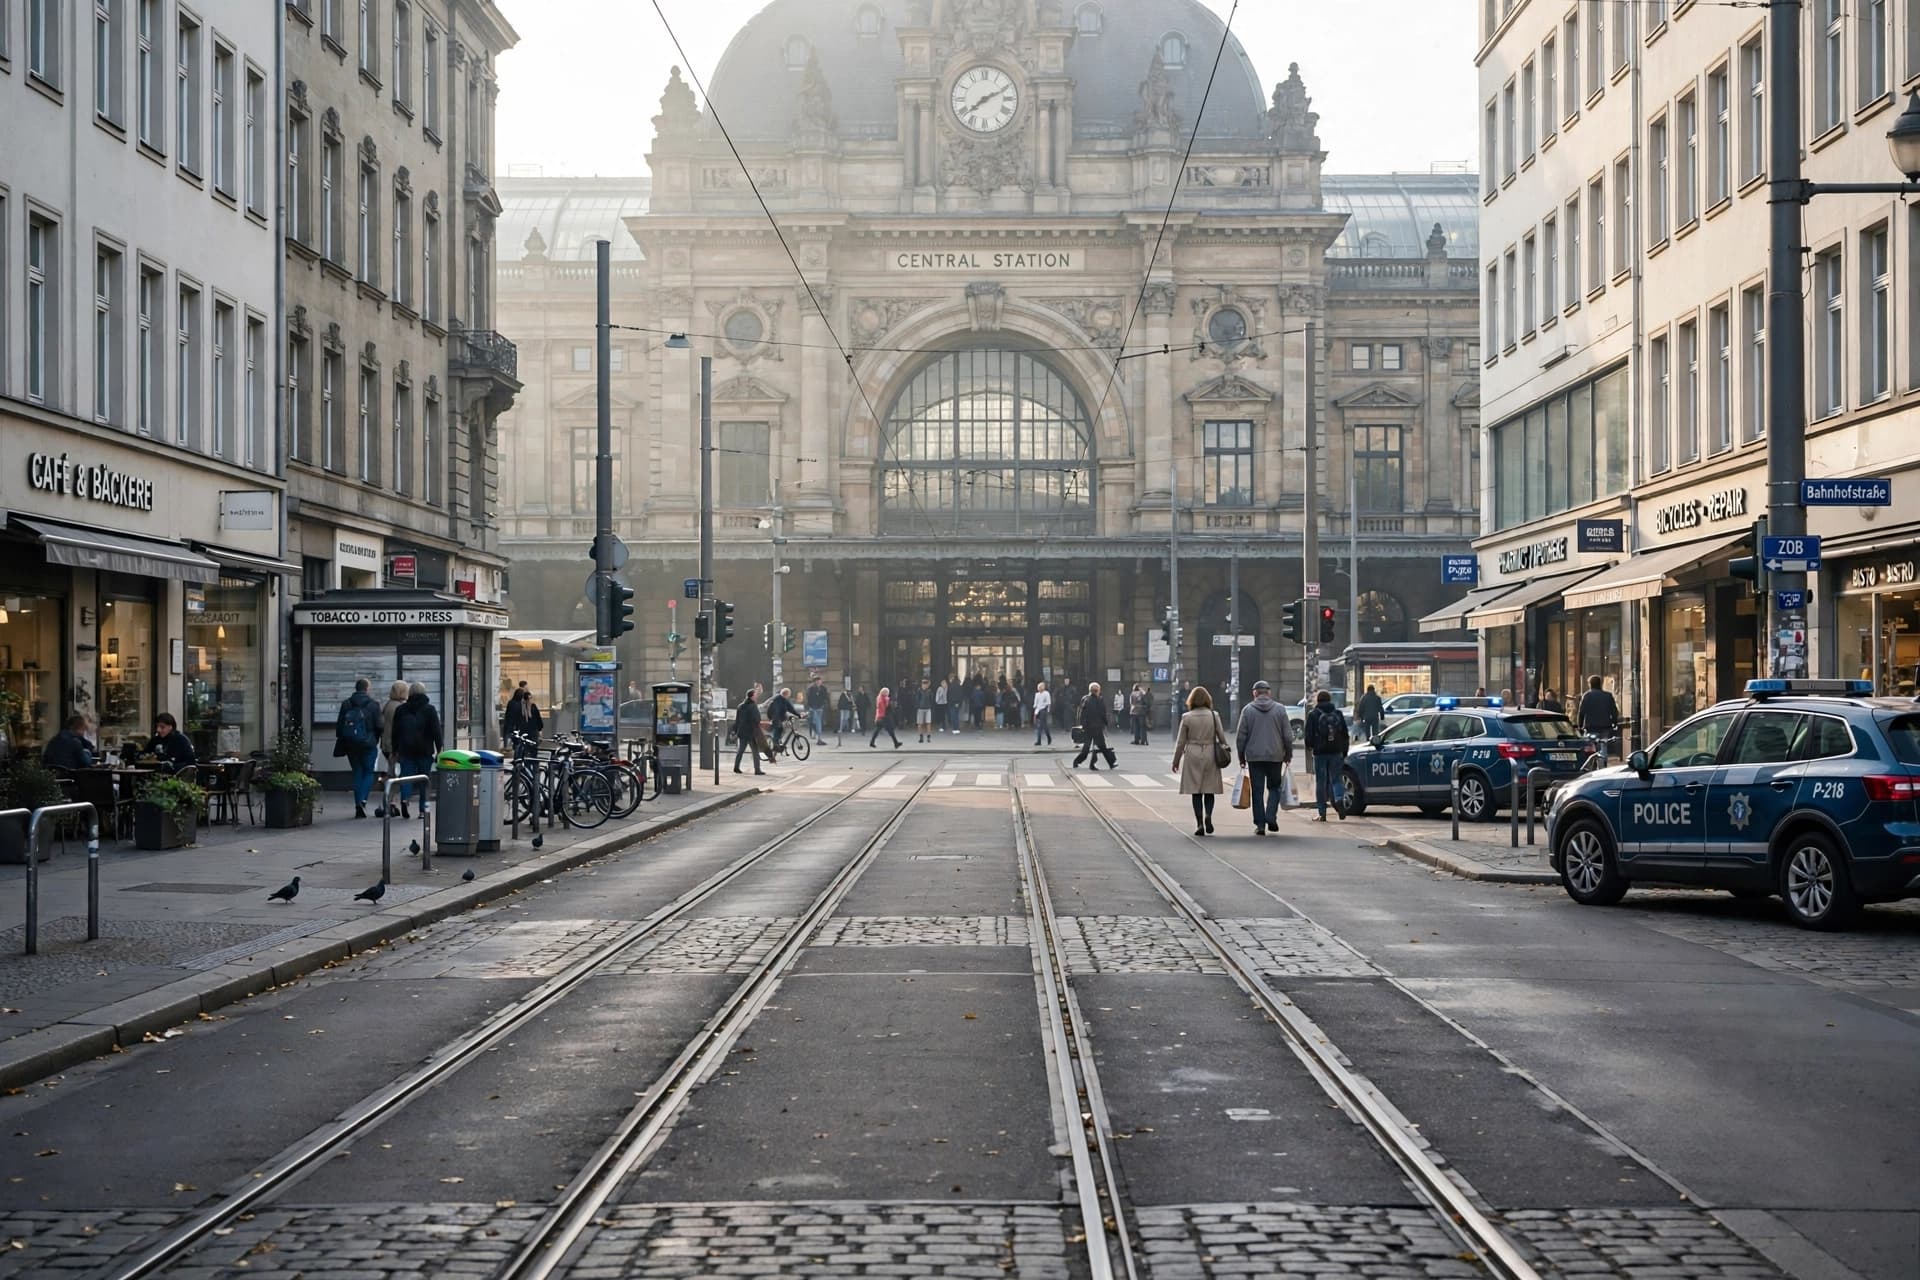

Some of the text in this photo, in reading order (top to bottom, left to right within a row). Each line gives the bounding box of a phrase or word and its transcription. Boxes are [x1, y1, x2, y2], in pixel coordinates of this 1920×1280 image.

[897, 253, 1070, 268] CENTRAL STATION
[29, 451, 155, 512] CAFÉ & BÄCKEREI
[1807, 484, 1886, 499] Bahnhofstraße
[1655, 499, 1701, 534] BICYCLES
[1708, 487, 1747, 522] REPAIR
[1778, 540, 1804, 555] ZOB
[311, 611, 360, 623] TOBACCO
[372, 611, 407, 623] LOTTO
[418, 611, 453, 622] PRESS
[1372, 762, 1410, 776] POLICE
[1812, 782, 1845, 799] P-218
[1634, 803, 1692, 824] POLICE
